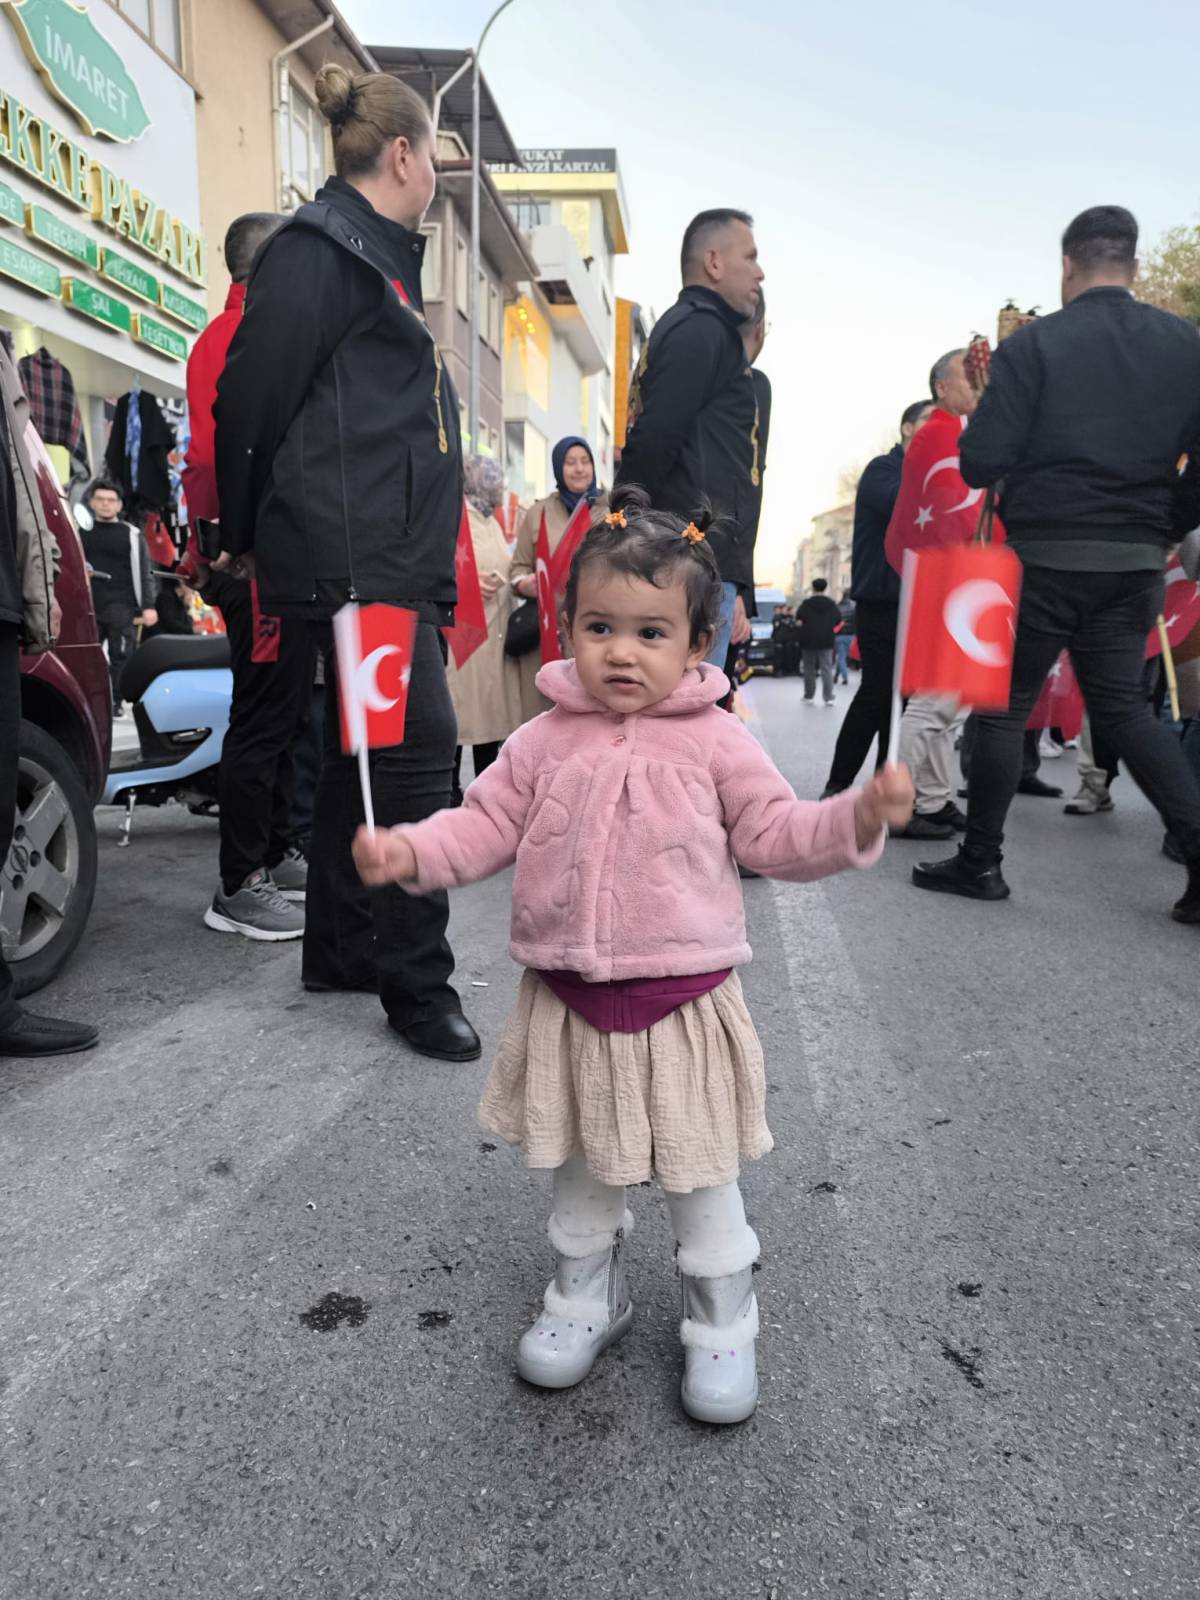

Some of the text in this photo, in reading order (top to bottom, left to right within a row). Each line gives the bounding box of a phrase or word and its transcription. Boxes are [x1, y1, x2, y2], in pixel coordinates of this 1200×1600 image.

[45, 14, 127, 121] İMARET
[553, 162, 609, 172] KARTAL
[101, 163, 208, 289] PAZARI
